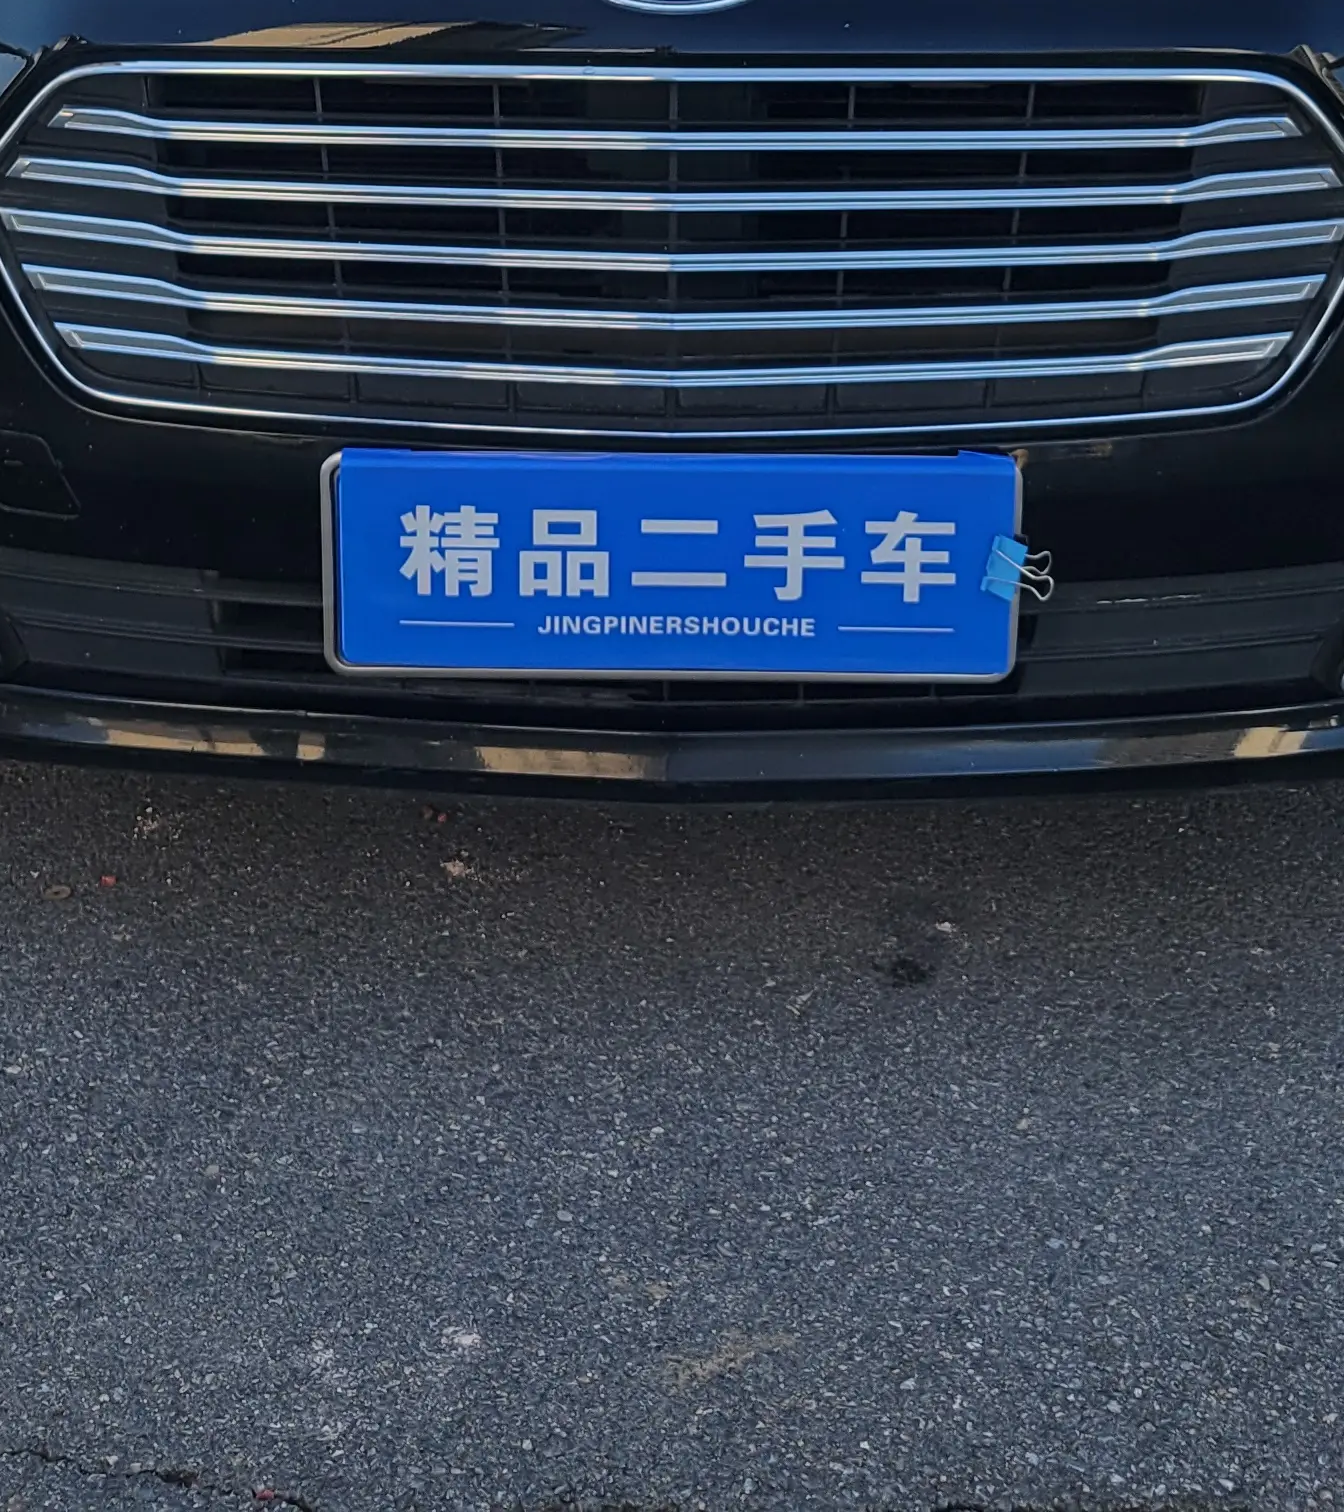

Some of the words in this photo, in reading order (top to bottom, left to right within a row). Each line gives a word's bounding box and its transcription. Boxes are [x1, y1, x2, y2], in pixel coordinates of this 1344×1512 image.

[399, 504, 957, 603] 精品二手车
[537, 614, 816, 639] JINGPINERSHOUCHE
